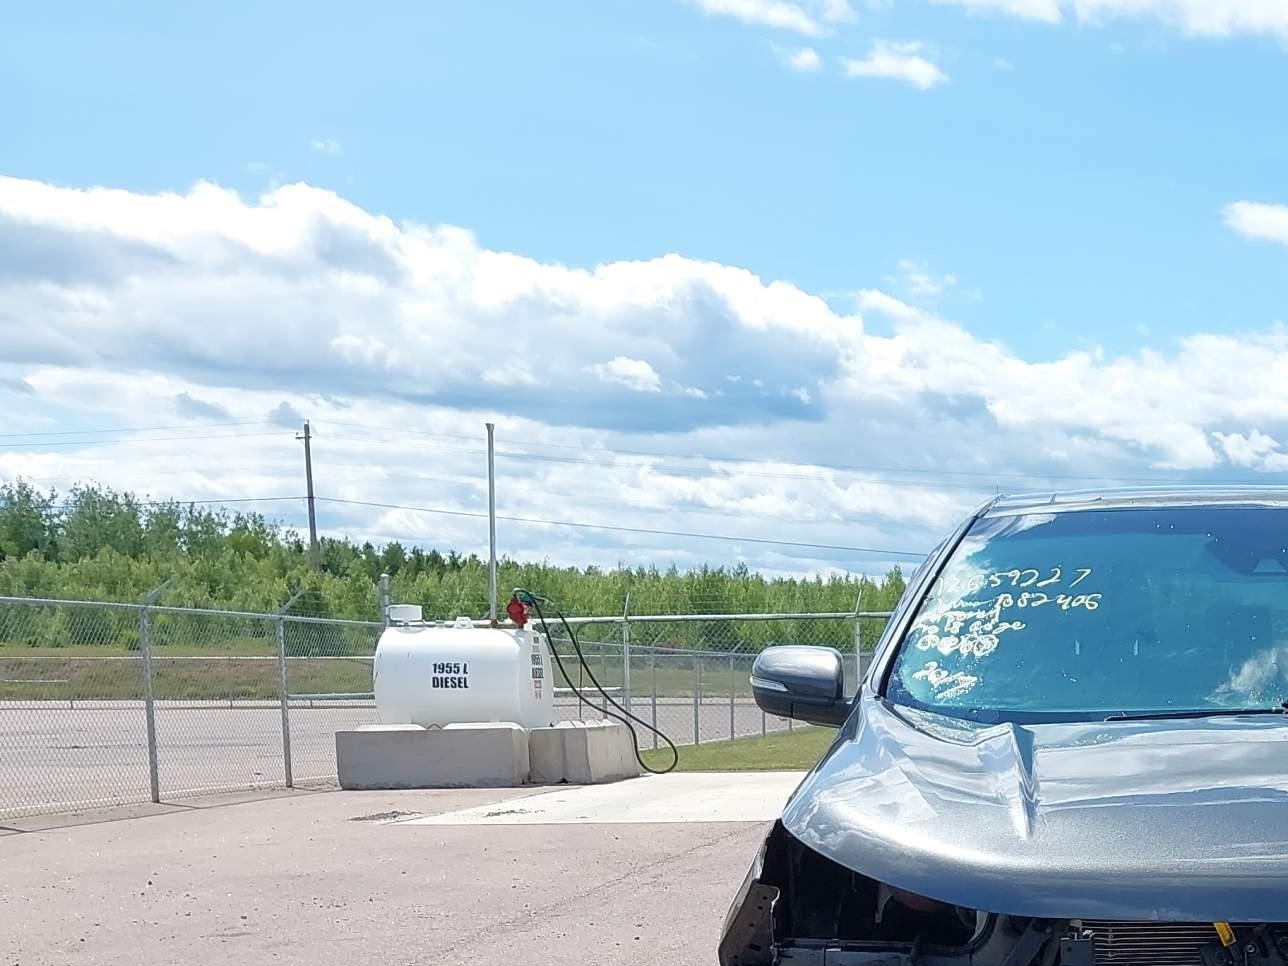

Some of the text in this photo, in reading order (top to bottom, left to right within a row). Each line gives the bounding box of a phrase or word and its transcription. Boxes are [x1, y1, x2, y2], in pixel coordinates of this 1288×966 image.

[432, 662, 469, 675] 1955 L
[431, 676, 470, 689] DIESEL
